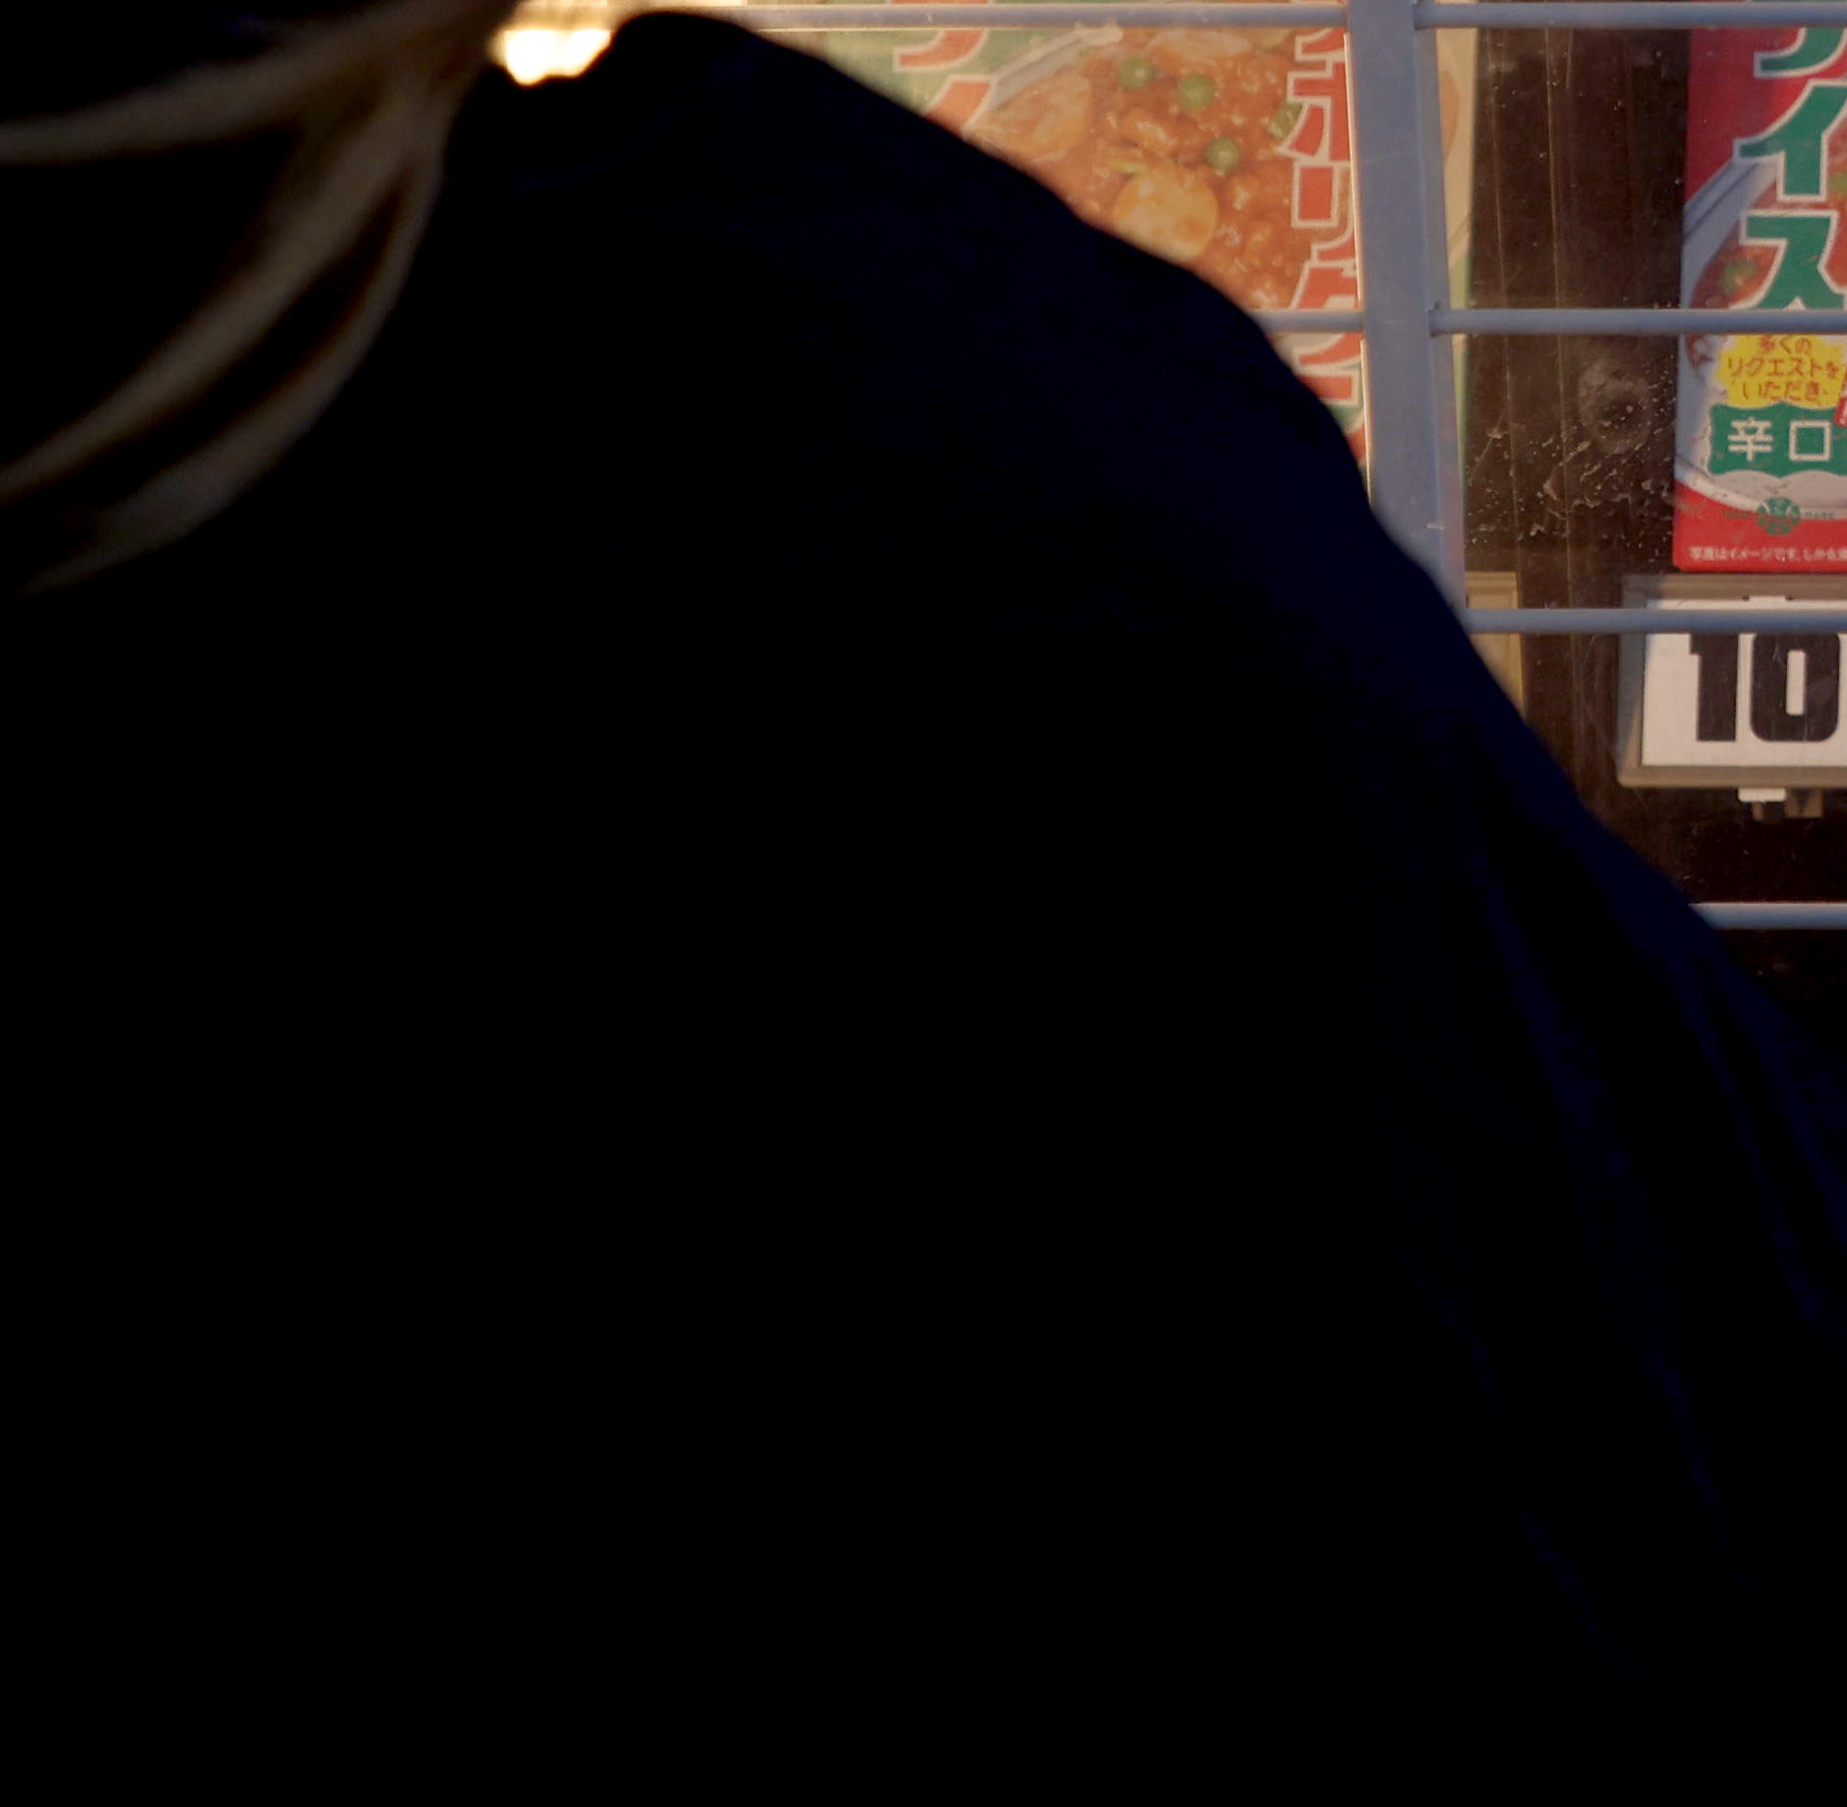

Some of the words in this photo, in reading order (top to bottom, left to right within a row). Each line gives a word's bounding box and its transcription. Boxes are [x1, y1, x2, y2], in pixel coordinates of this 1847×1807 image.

[1727, 358, 1840, 380] リクエストを
[1728, 418, 1832, 462] 辛口
[1689, 630, 1841, 742] 10
